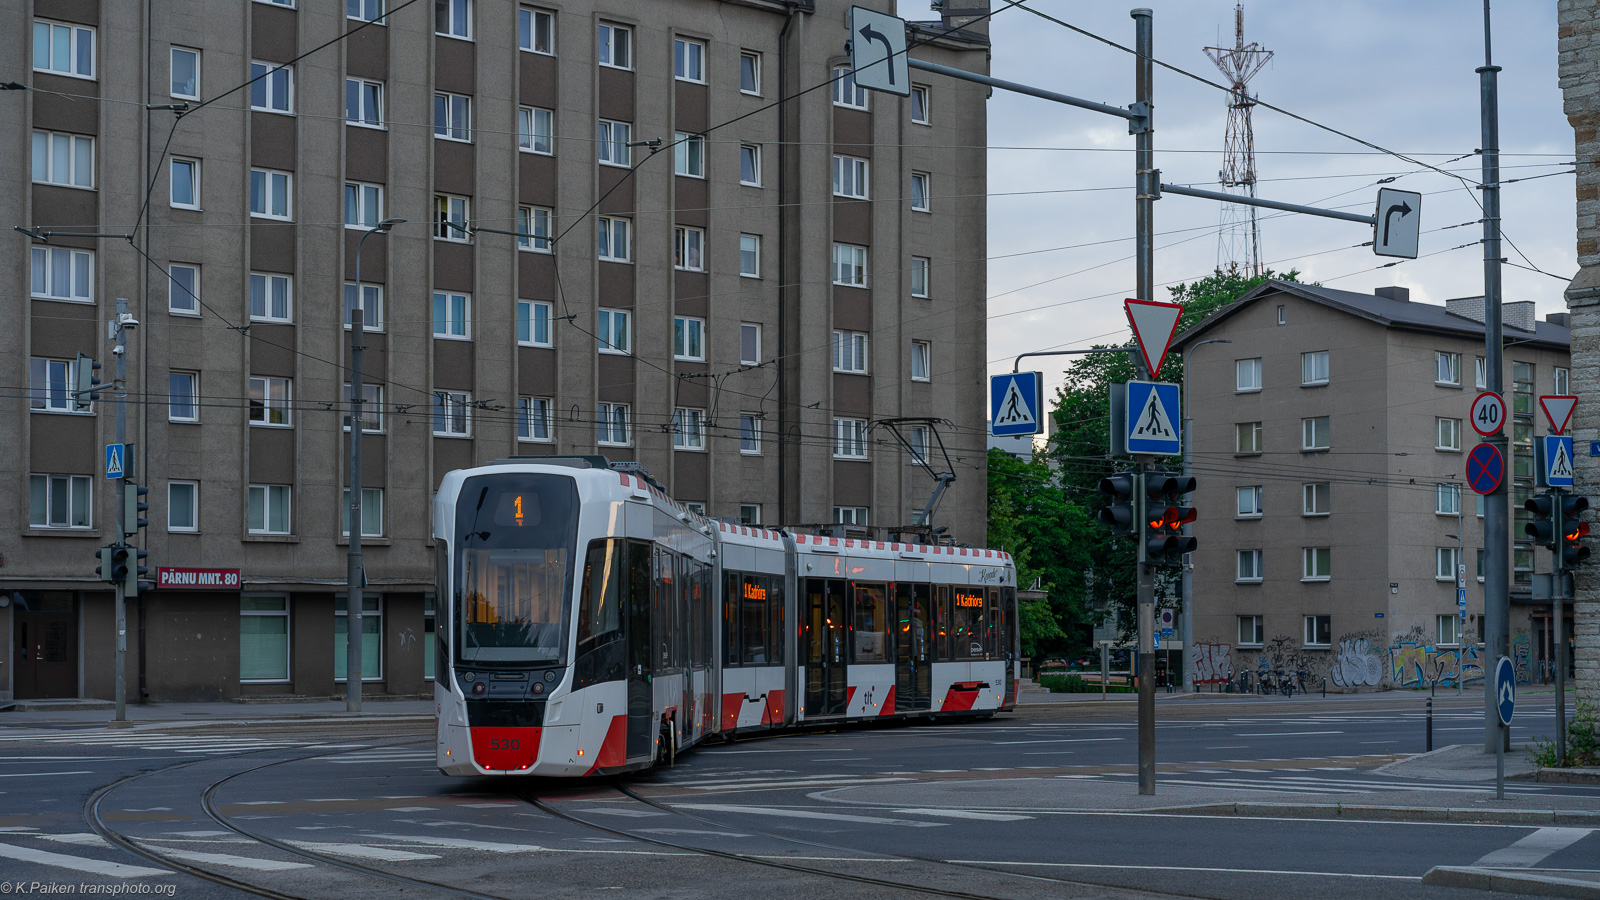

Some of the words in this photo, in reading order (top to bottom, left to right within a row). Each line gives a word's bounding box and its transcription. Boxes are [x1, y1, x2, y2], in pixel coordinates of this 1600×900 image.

[1478, 403, 1498, 424] 40
[514, 496, 524, 519] 1
[161, 568, 197, 585] PÄRNU
[198, 572, 223, 585] MNT.
[224, 573, 238, 585] 80
[490, 738, 521, 751] 530
